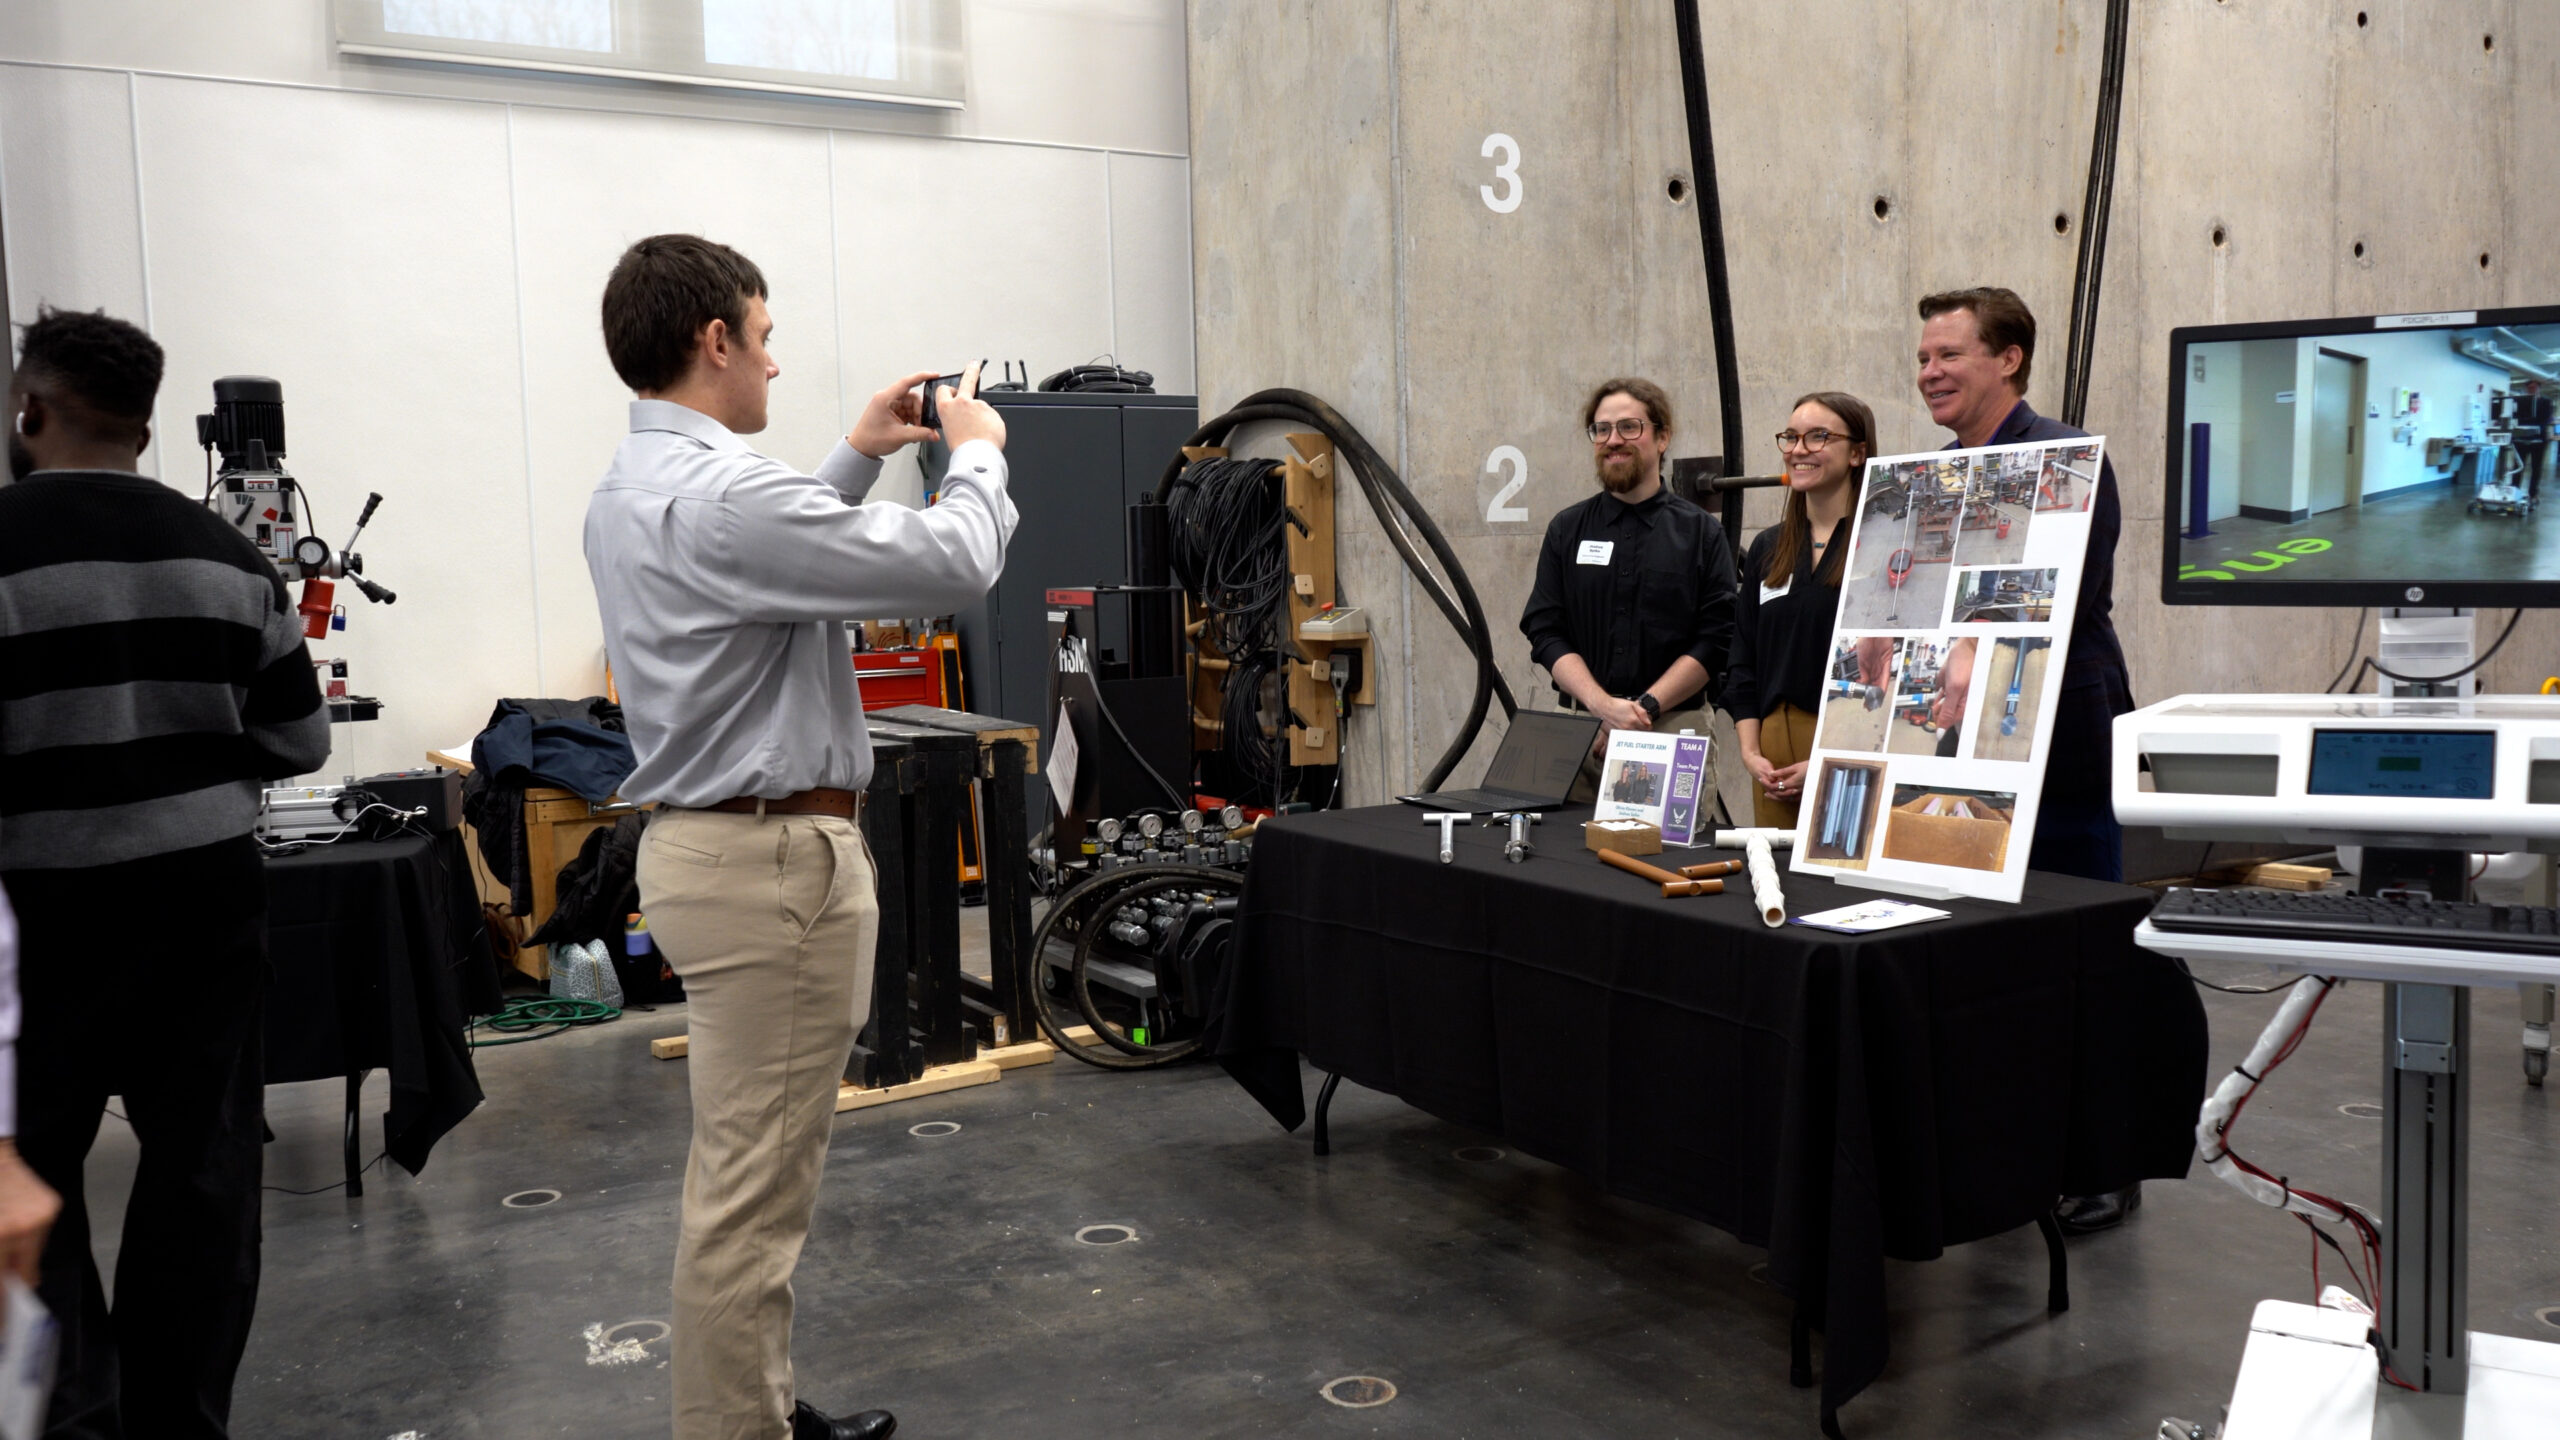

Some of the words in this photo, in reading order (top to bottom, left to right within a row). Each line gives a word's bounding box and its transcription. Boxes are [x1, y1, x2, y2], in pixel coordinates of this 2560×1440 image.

[1480, 132, 1524, 214] 3
[1485, 445, 1529, 522] 2
[1681, 742, 1697, 751] TEAM
